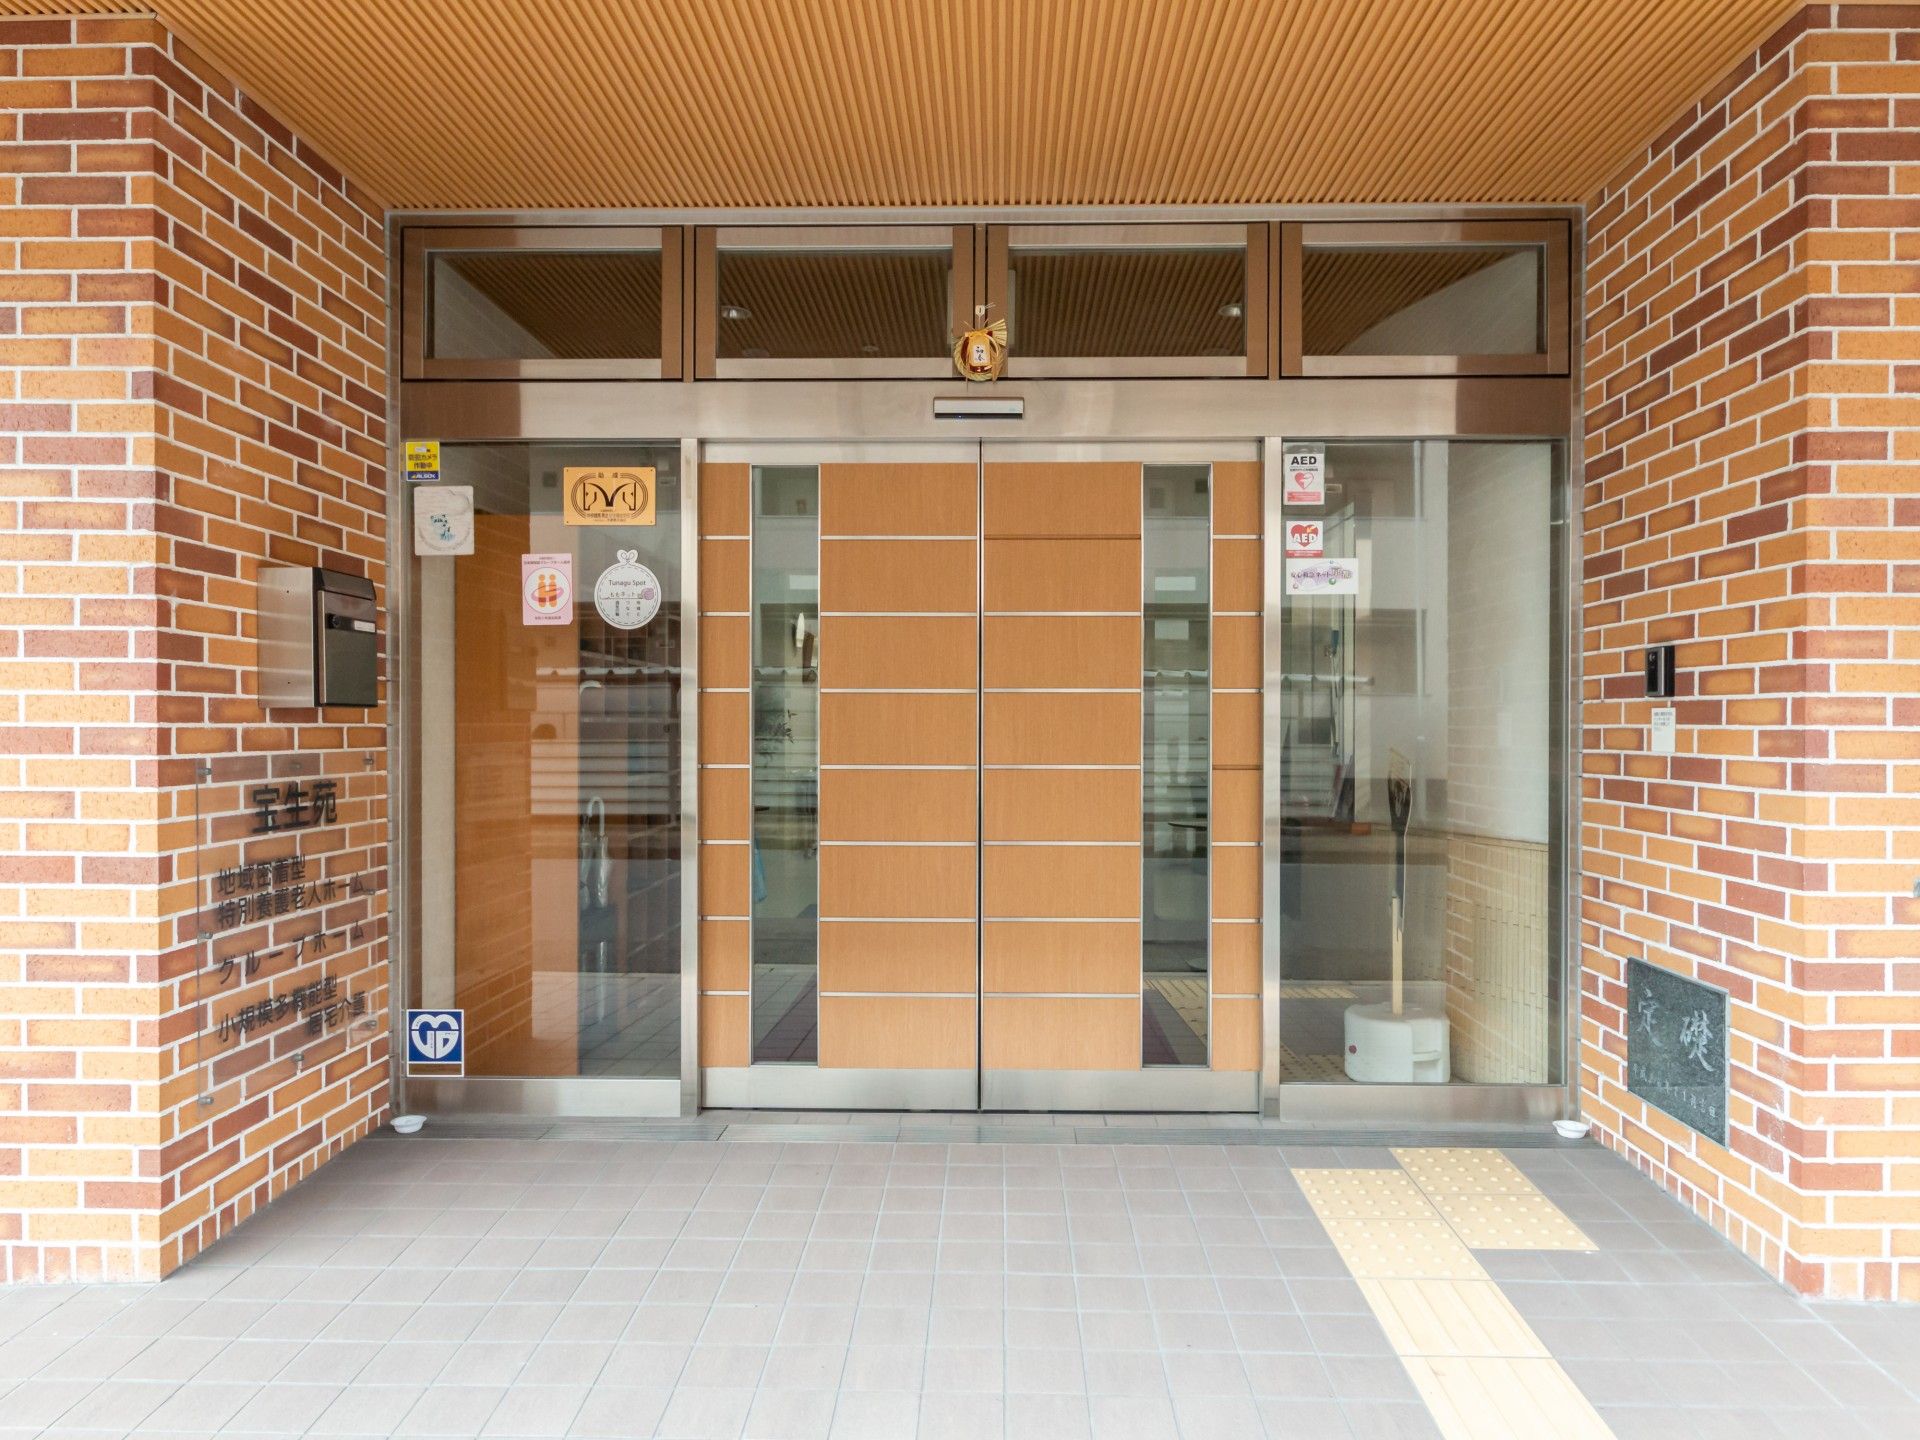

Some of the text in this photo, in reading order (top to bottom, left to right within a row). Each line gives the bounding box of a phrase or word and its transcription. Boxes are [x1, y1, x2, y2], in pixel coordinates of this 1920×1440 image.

[1291, 456, 1317, 465] AED
[1293, 533, 1317, 543] AED
[252, 780, 338, 833] 宝生苑
[217, 854, 306, 895] 地域密着型
[217, 872, 364, 929] 特別養護老人ホーム
[219, 920, 364, 985] グループホーム
[219, 973, 338, 1043] 小規模多機能型
[308, 990, 366, 1036] 居宅介護
